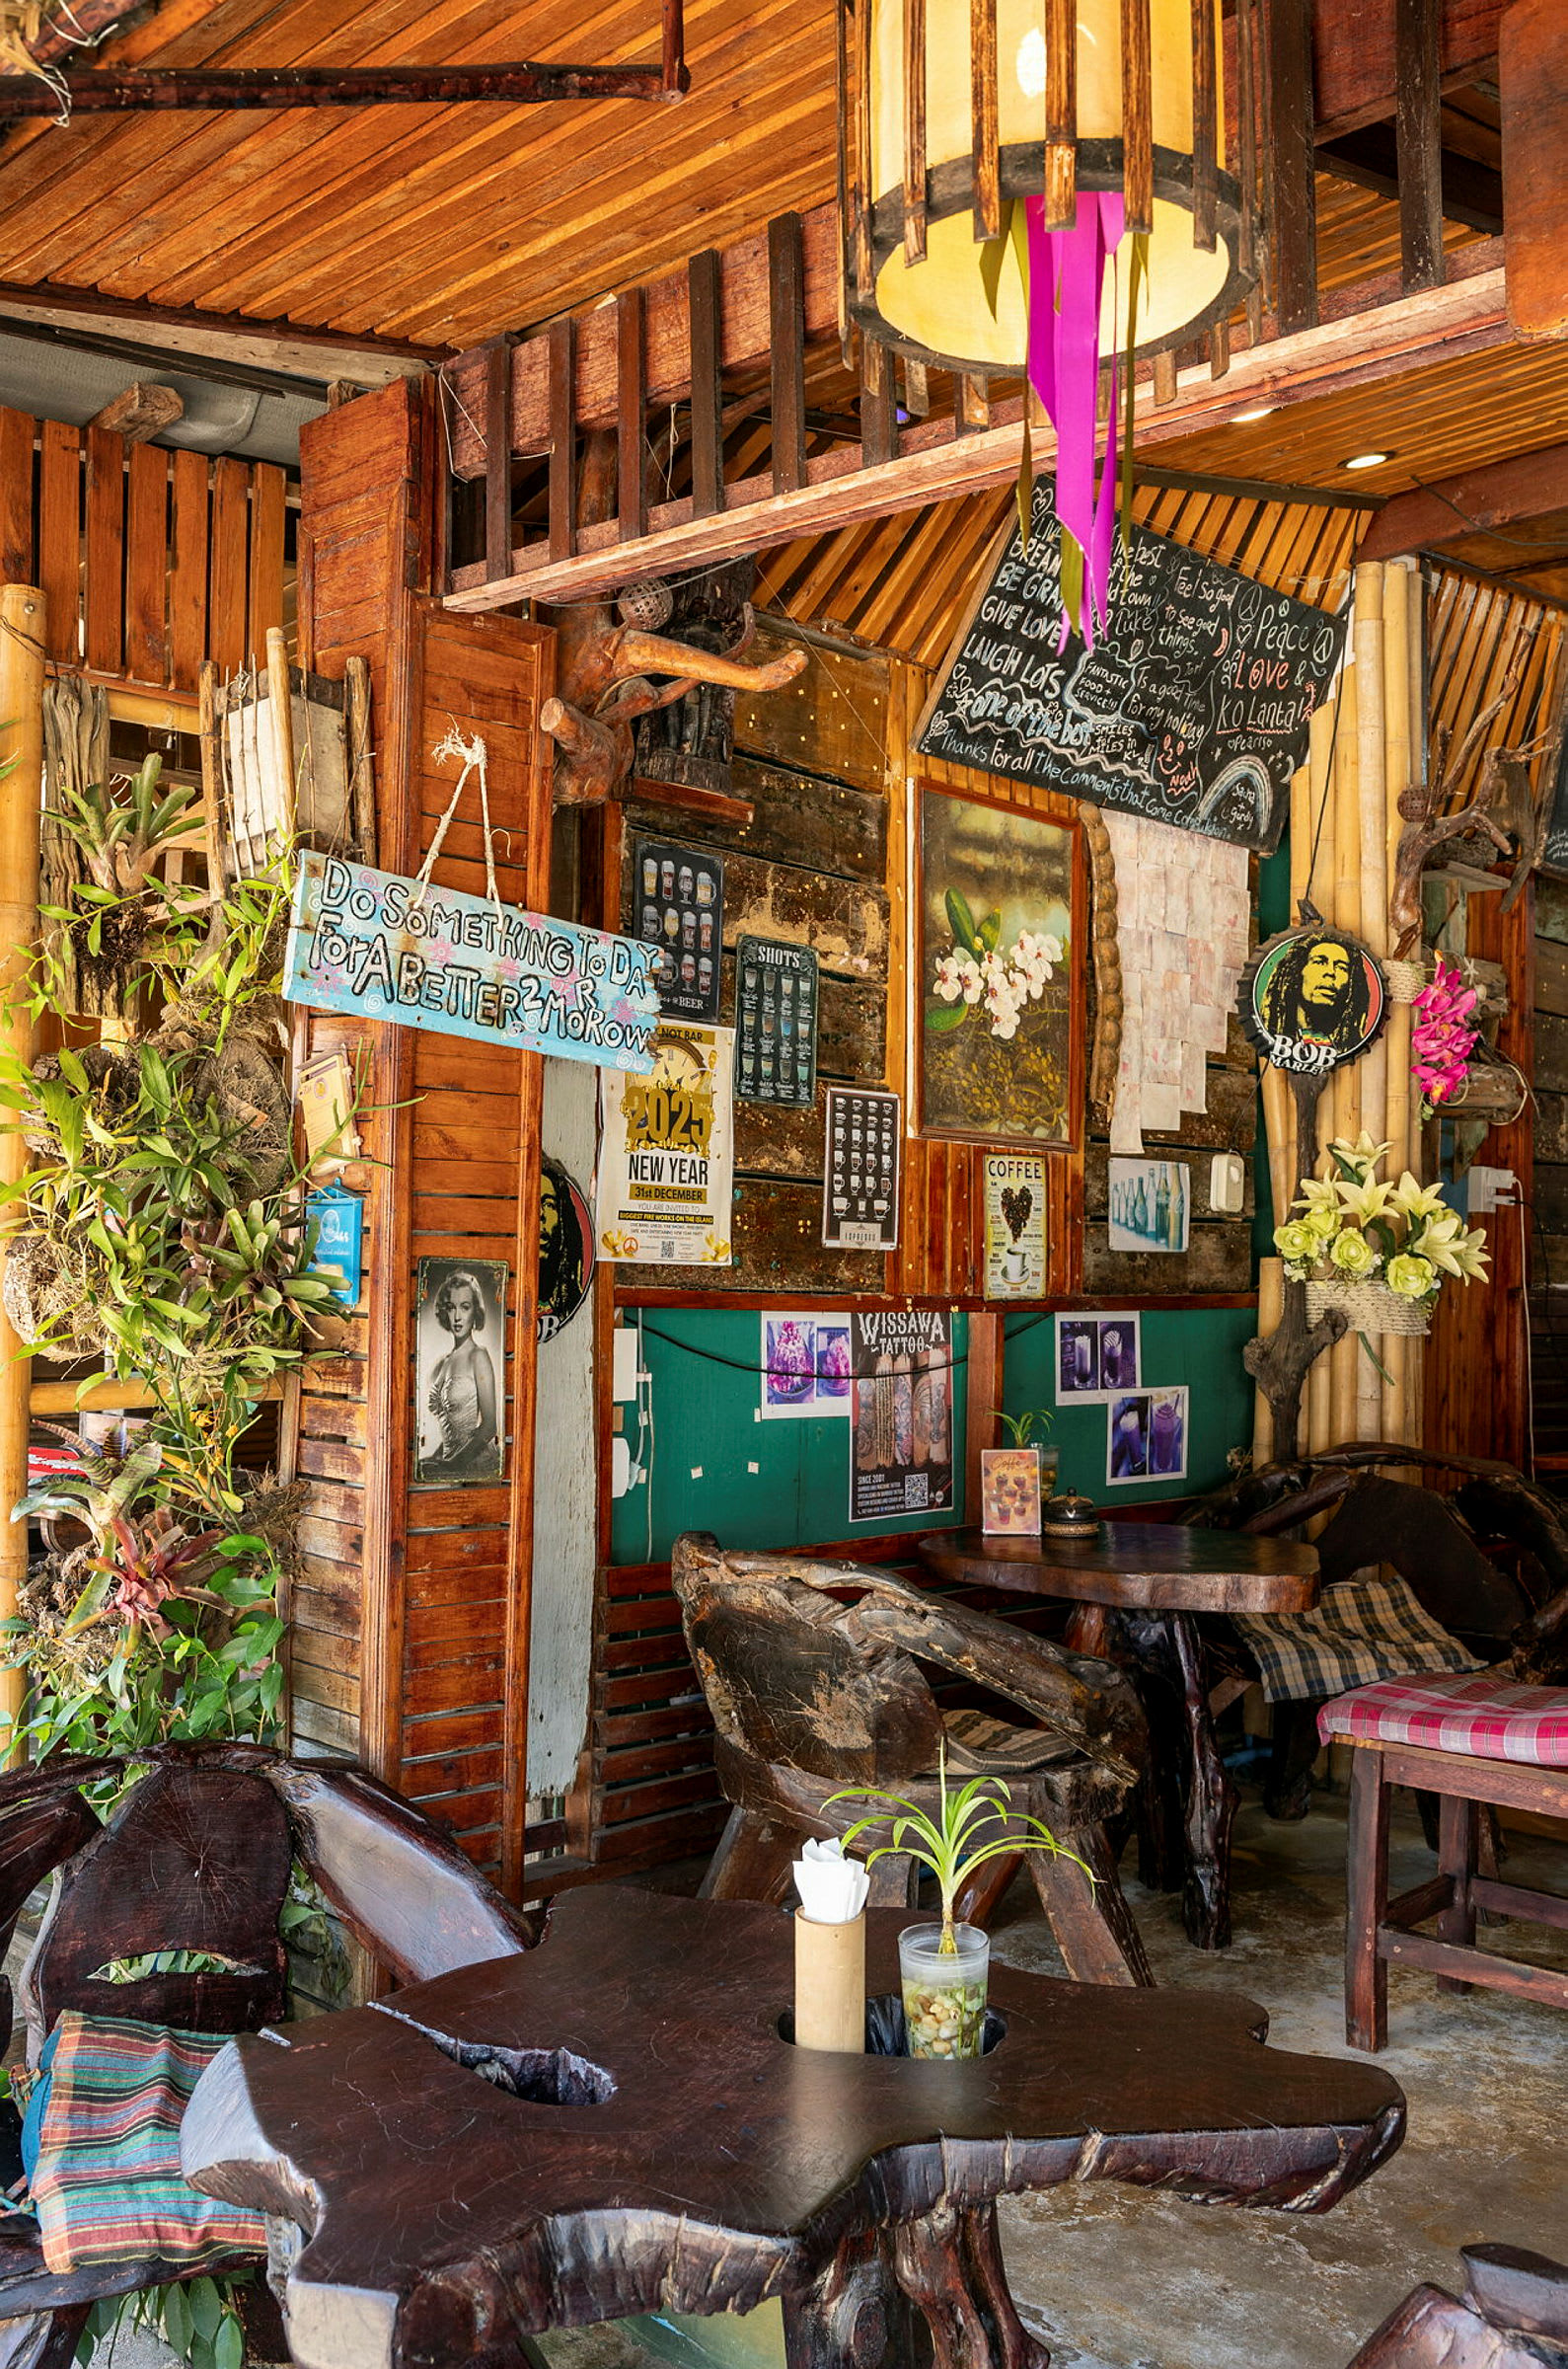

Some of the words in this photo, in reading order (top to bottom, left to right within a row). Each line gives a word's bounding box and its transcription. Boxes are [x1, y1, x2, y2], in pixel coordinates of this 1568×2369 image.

[1134, 536, 1166, 569] best
[995, 562, 1026, 591] BE
[1174, 566, 1204, 598] Feel
[981, 595, 1025, 631] GIVE
[1020, 607, 1063, 649] LOVE
[1253, 604, 1310, 659] Peace
[962, 633, 1022, 676] LAUGH
[1019, 654, 1066, 700] LOTS
[1085, 661, 1130, 689] FANTASTIC
[1079, 676, 1103, 694] FOOD
[1149, 683, 1157, 694] a
[1094, 724, 1135, 737] SMILES
[1146, 706, 1165, 731] my
[1088, 738, 1124, 755] MILES
[940, 727, 988, 763] Thanks
[1010, 747, 1036, 773] all
[1119, 780, 1151, 809] that
[757, 945, 800, 969] SHOTS
[351, 933, 396, 1004] A
[395, 951, 522, 1030] BETTER
[679, 995, 704, 1010] BEER
[661, 1028, 682, 1039] NOT
[685, 1031, 704, 1043] BAR
[1271, 1034, 1338, 1068] BOB
[626, 1086, 713, 1146] 2025
[629, 1154, 664, 1183] NEW
[669, 1157, 709, 1185] YEAR
[988, 1160, 1042, 1179] COFFEE
[635, 1185, 652, 1198] 31st
[653, 1187, 703, 1201] DECEMBER
[858, 1312, 945, 1345] WISSAWA
[879, 1337, 926, 1355] TATTOO
